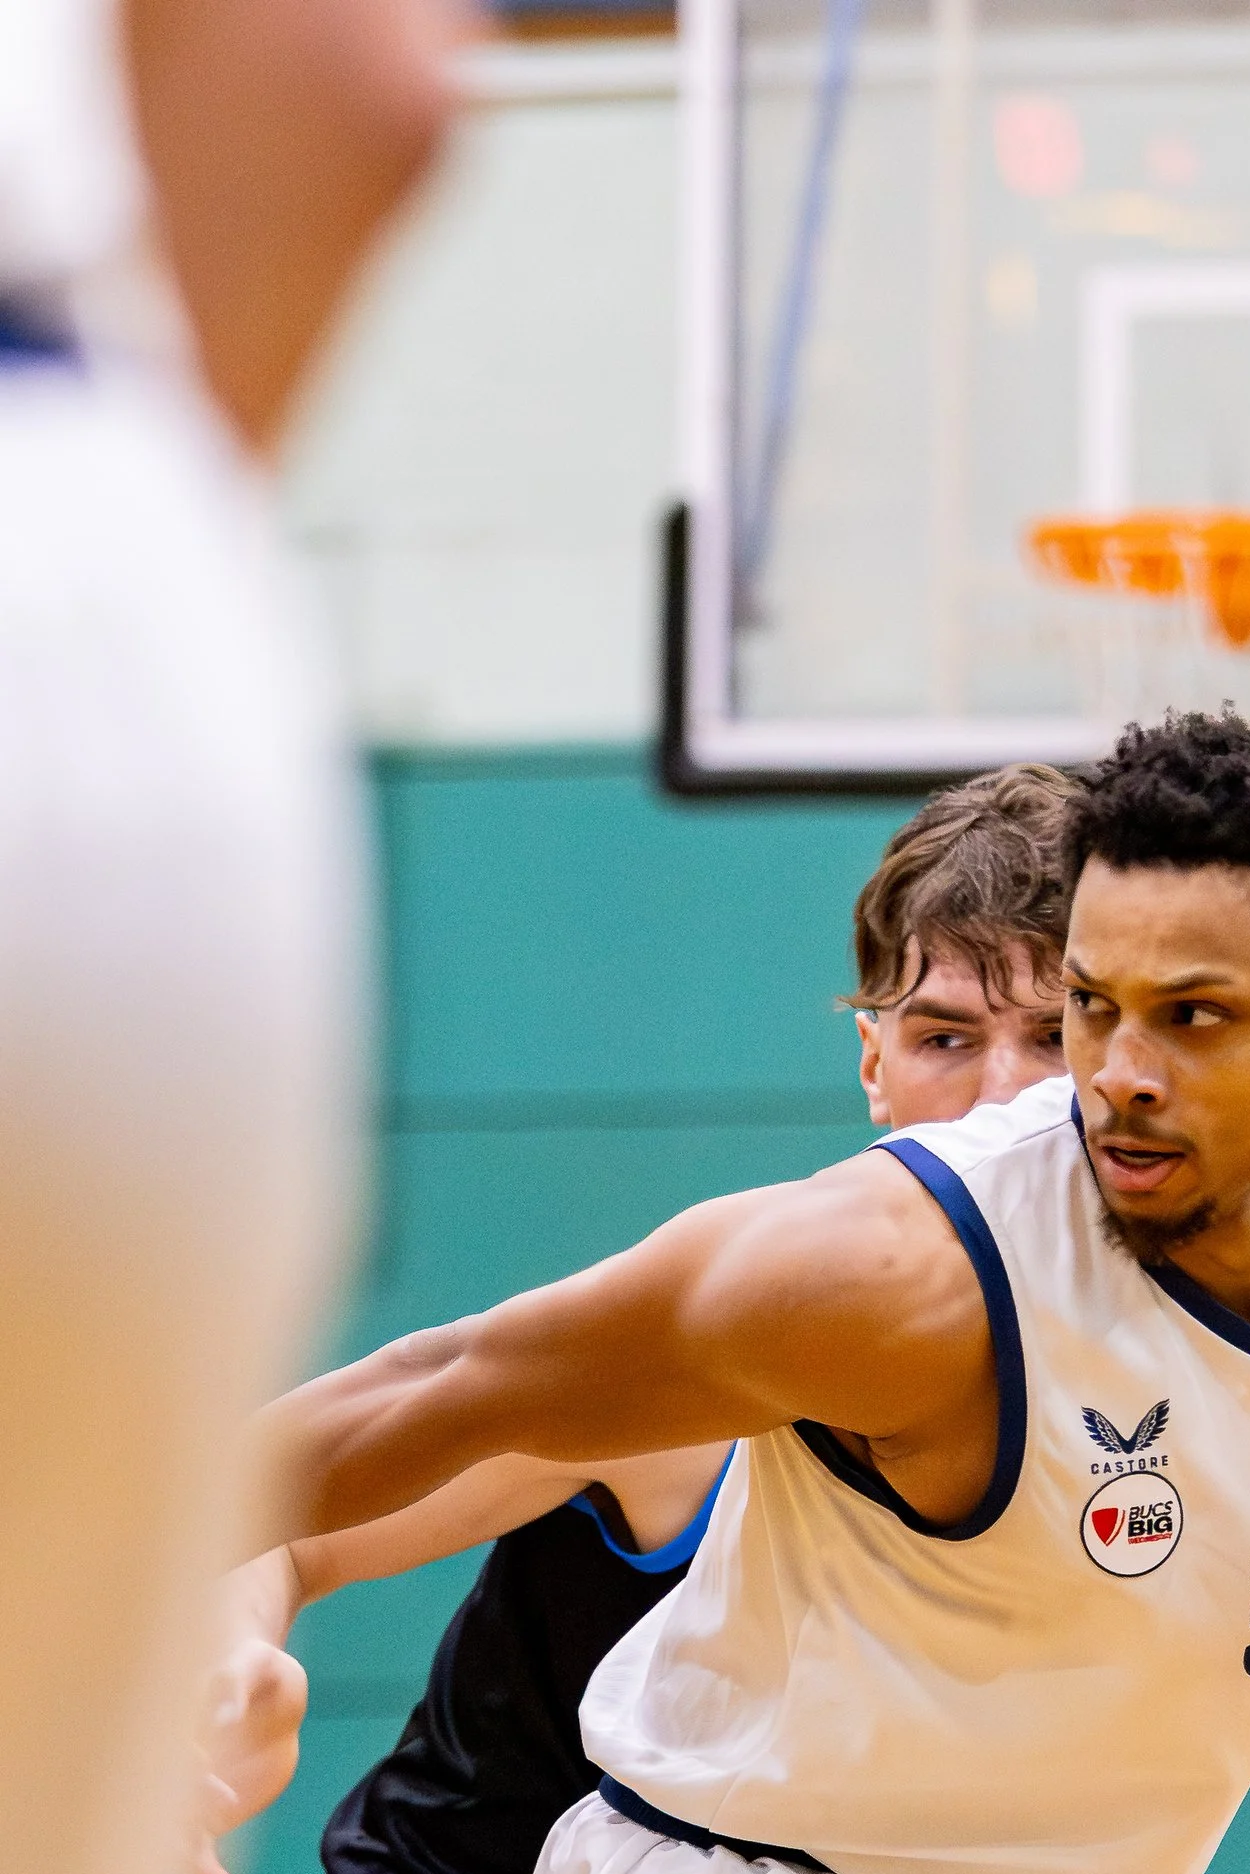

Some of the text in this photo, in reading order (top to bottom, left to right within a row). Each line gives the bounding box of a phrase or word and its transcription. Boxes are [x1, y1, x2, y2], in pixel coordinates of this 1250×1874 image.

[1091, 1455, 1170, 1475] CASTORE
[1128, 1500, 1173, 1521] BUCS
[1127, 1516, 1173, 1538] BIG
